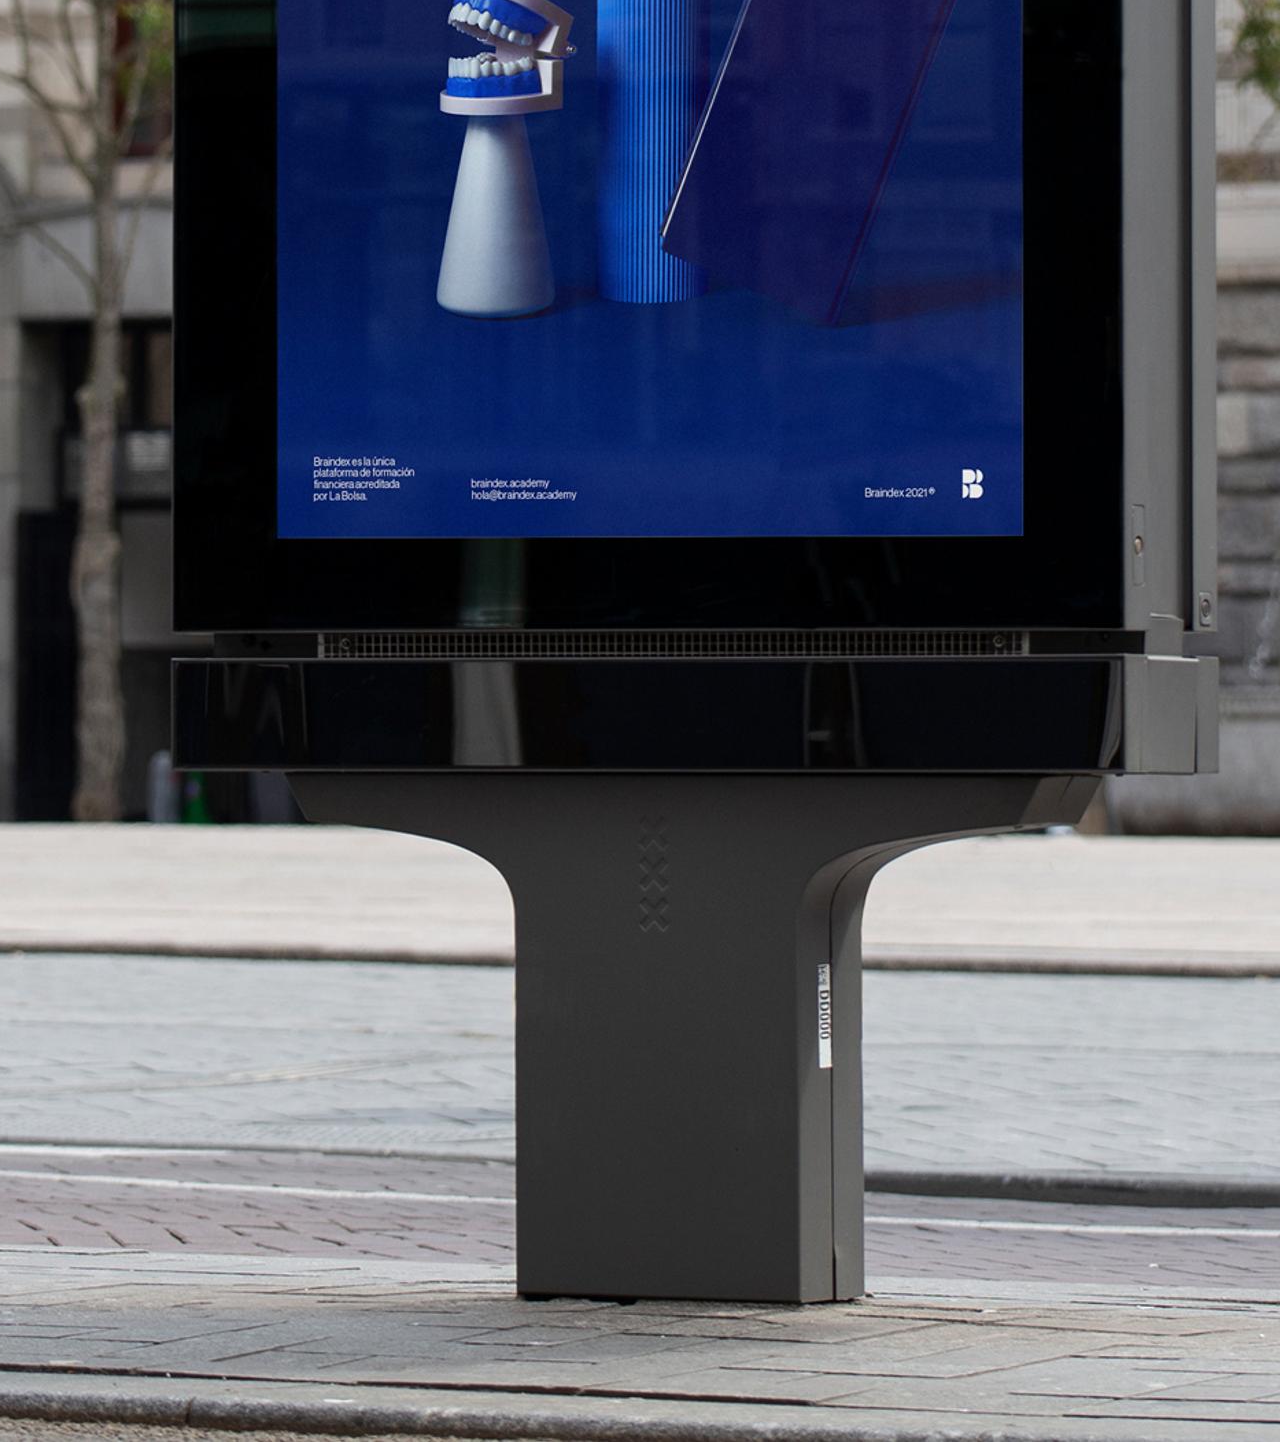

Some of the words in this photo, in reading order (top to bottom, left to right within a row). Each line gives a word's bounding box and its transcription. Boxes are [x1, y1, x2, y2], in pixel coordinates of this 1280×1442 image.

[313, 456, 351, 467] Braindex
[351, 459, 362, 467] es
[363, 457, 371, 467] la
[372, 457, 396, 467] única
[313, 468, 359, 479] plataforma
[359, 467, 371, 478] de
[372, 467, 415, 478] formación
[313, 479, 355, 489] financiera
[355, 479, 401, 489] acreditada
[470, 478, 550, 489] braindex.academy
[313, 492, 328, 502] por
[328, 491, 341, 501] La
[864, 487, 905, 498] Braindex
